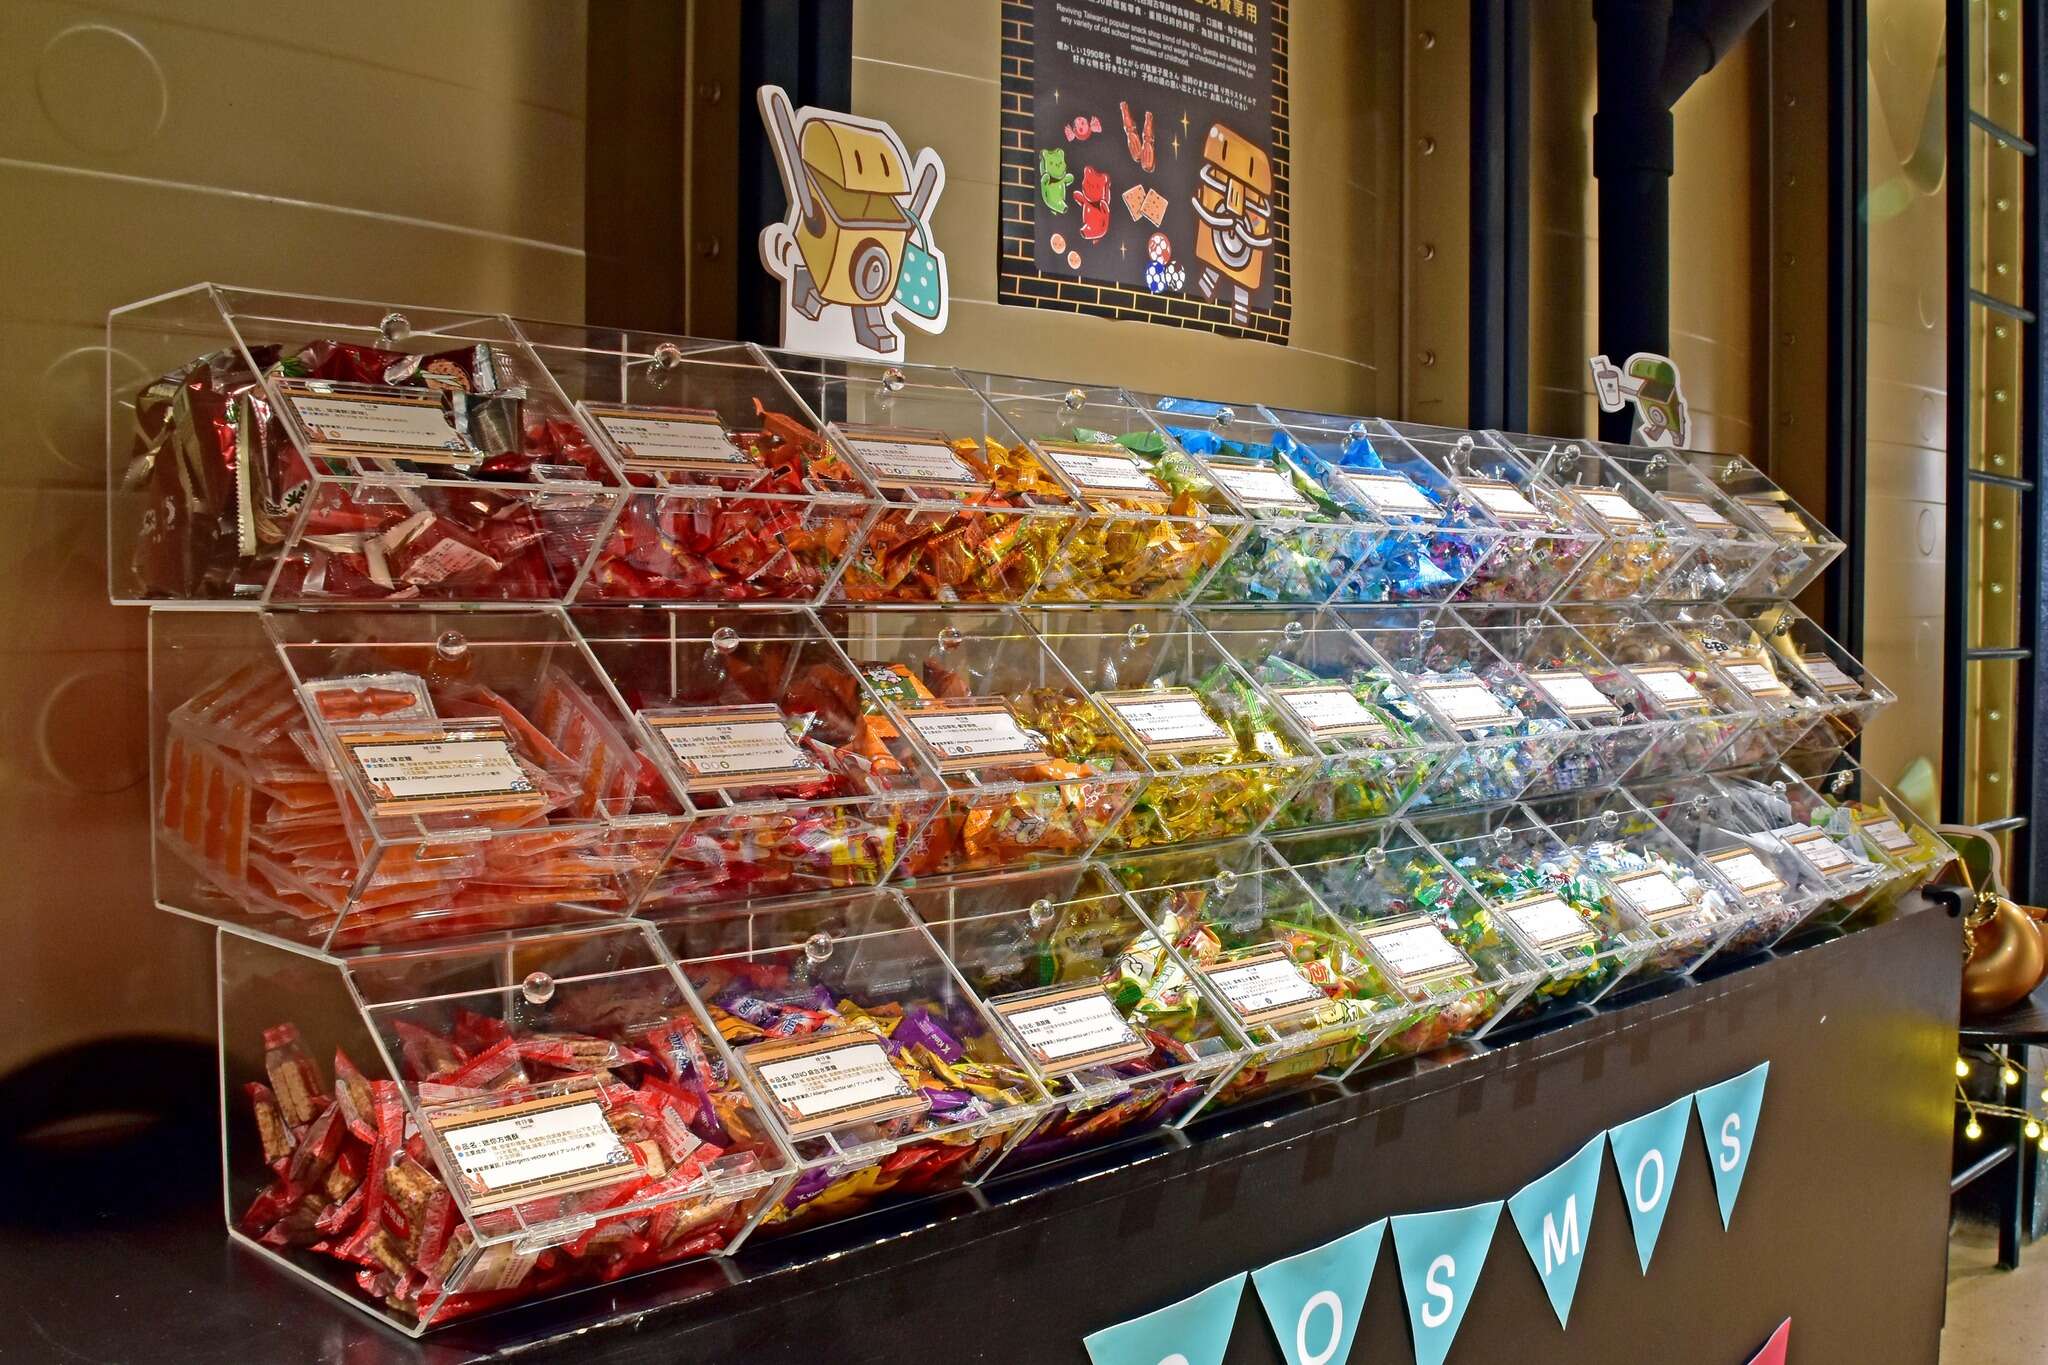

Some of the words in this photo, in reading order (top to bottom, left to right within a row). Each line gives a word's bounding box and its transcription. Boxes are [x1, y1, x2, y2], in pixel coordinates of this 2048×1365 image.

[1056, 3, 1082, 19] Reviving
[1083, 10, 1108, 24] Taiwan's
[1109, 18, 1130, 30] popular
[1131, 25, 1146, 35] snack
[1147, 30, 1161, 41] shop
[1061, 15, 1072, 25] any
[1073, 19, 1093, 31] variety
[1101, 26, 1110, 34] old
[1111, 29, 1129, 39] school
[1130, 33, 1146, 44] snack
[1162, 43, 1173, 52] and
[1130, 44, 1157, 57] memories
